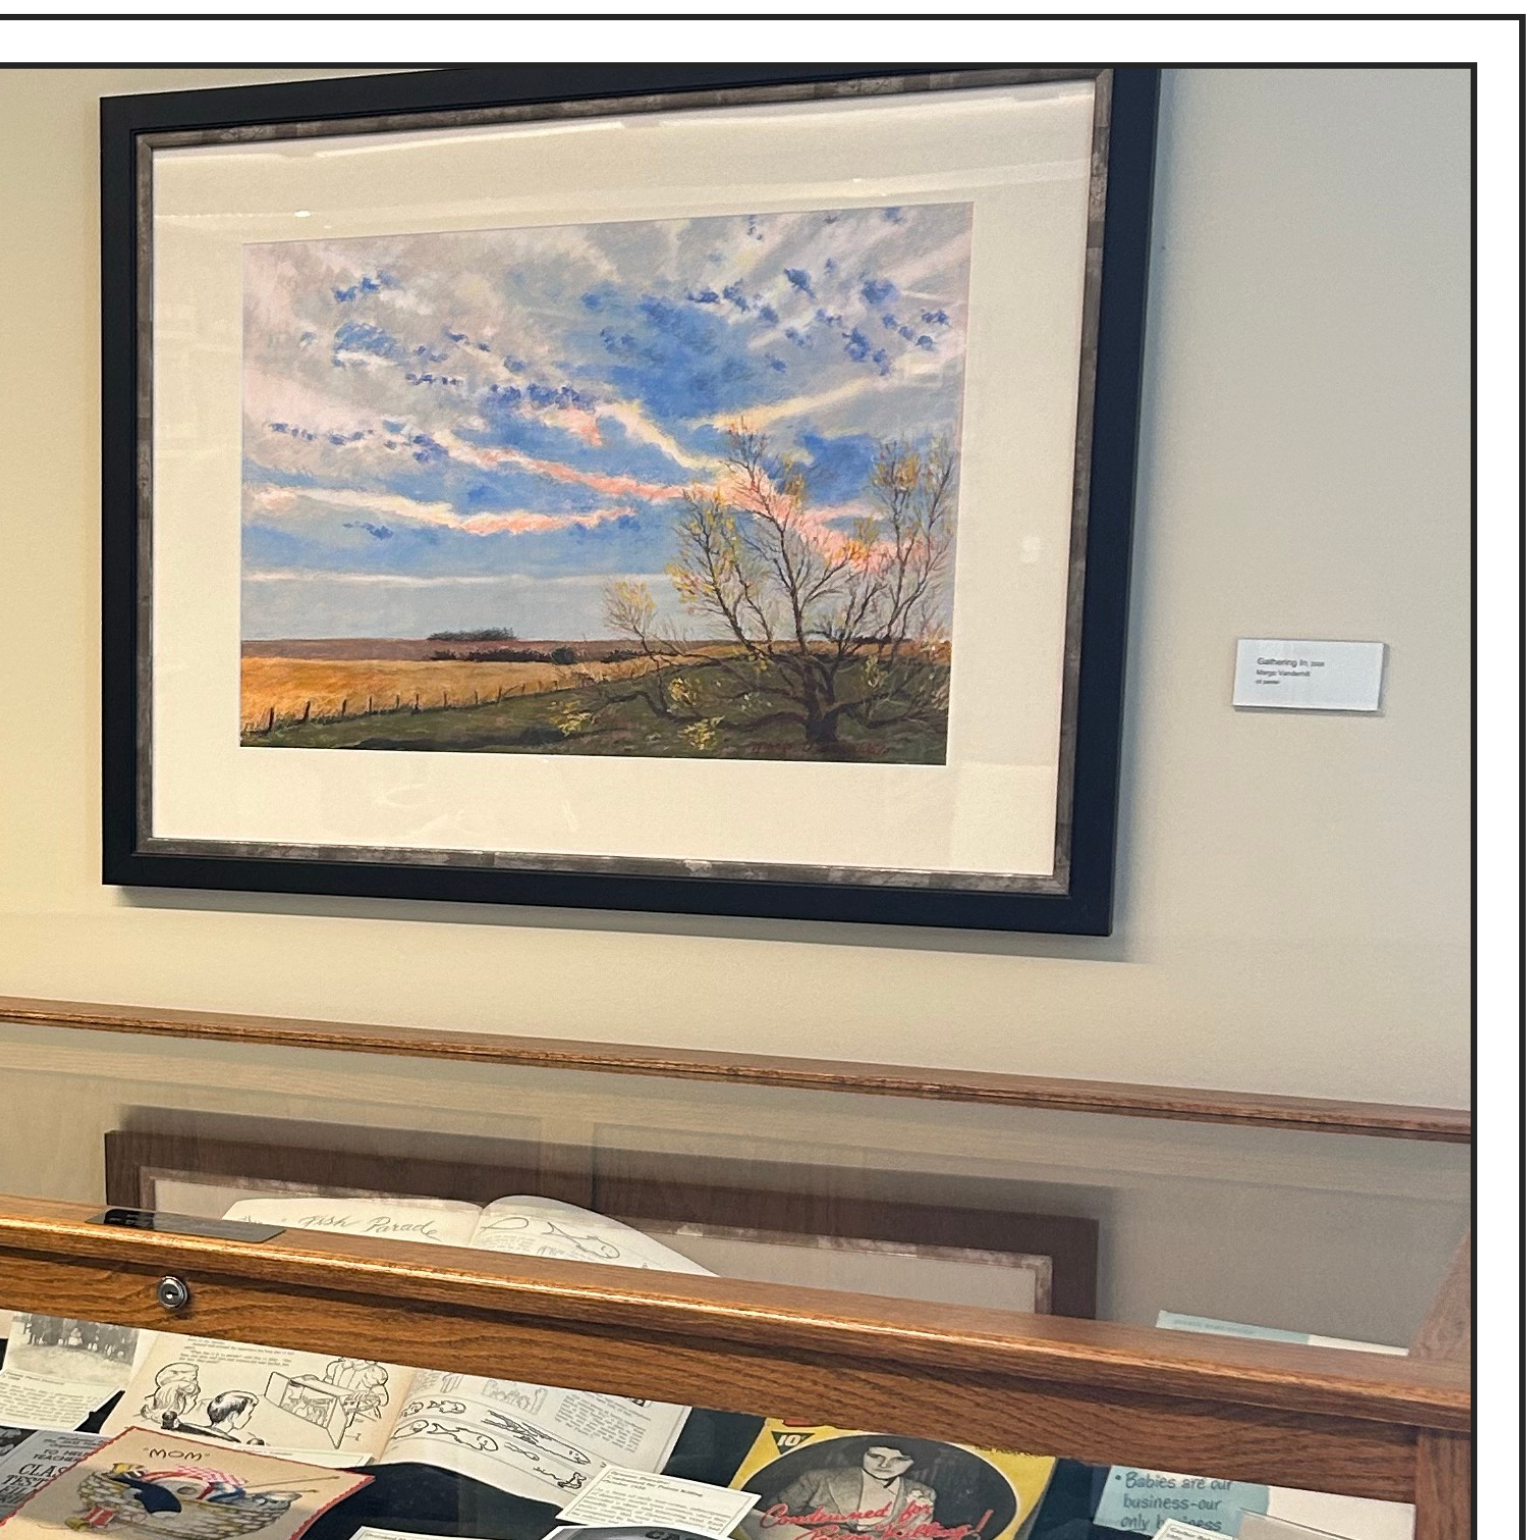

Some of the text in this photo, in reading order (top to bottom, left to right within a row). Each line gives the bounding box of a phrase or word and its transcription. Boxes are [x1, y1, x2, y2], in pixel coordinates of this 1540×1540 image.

[1257, 657, 1298, 668] Gathering
[364, 1216, 442, 1242] Parade
[1125, 1471, 1233, 1491] Babies are our
[760, 1501, 893, 1529] Condemned
[898, 1501, 932, 1524] for
[1120, 1513, 1150, 1532] only
